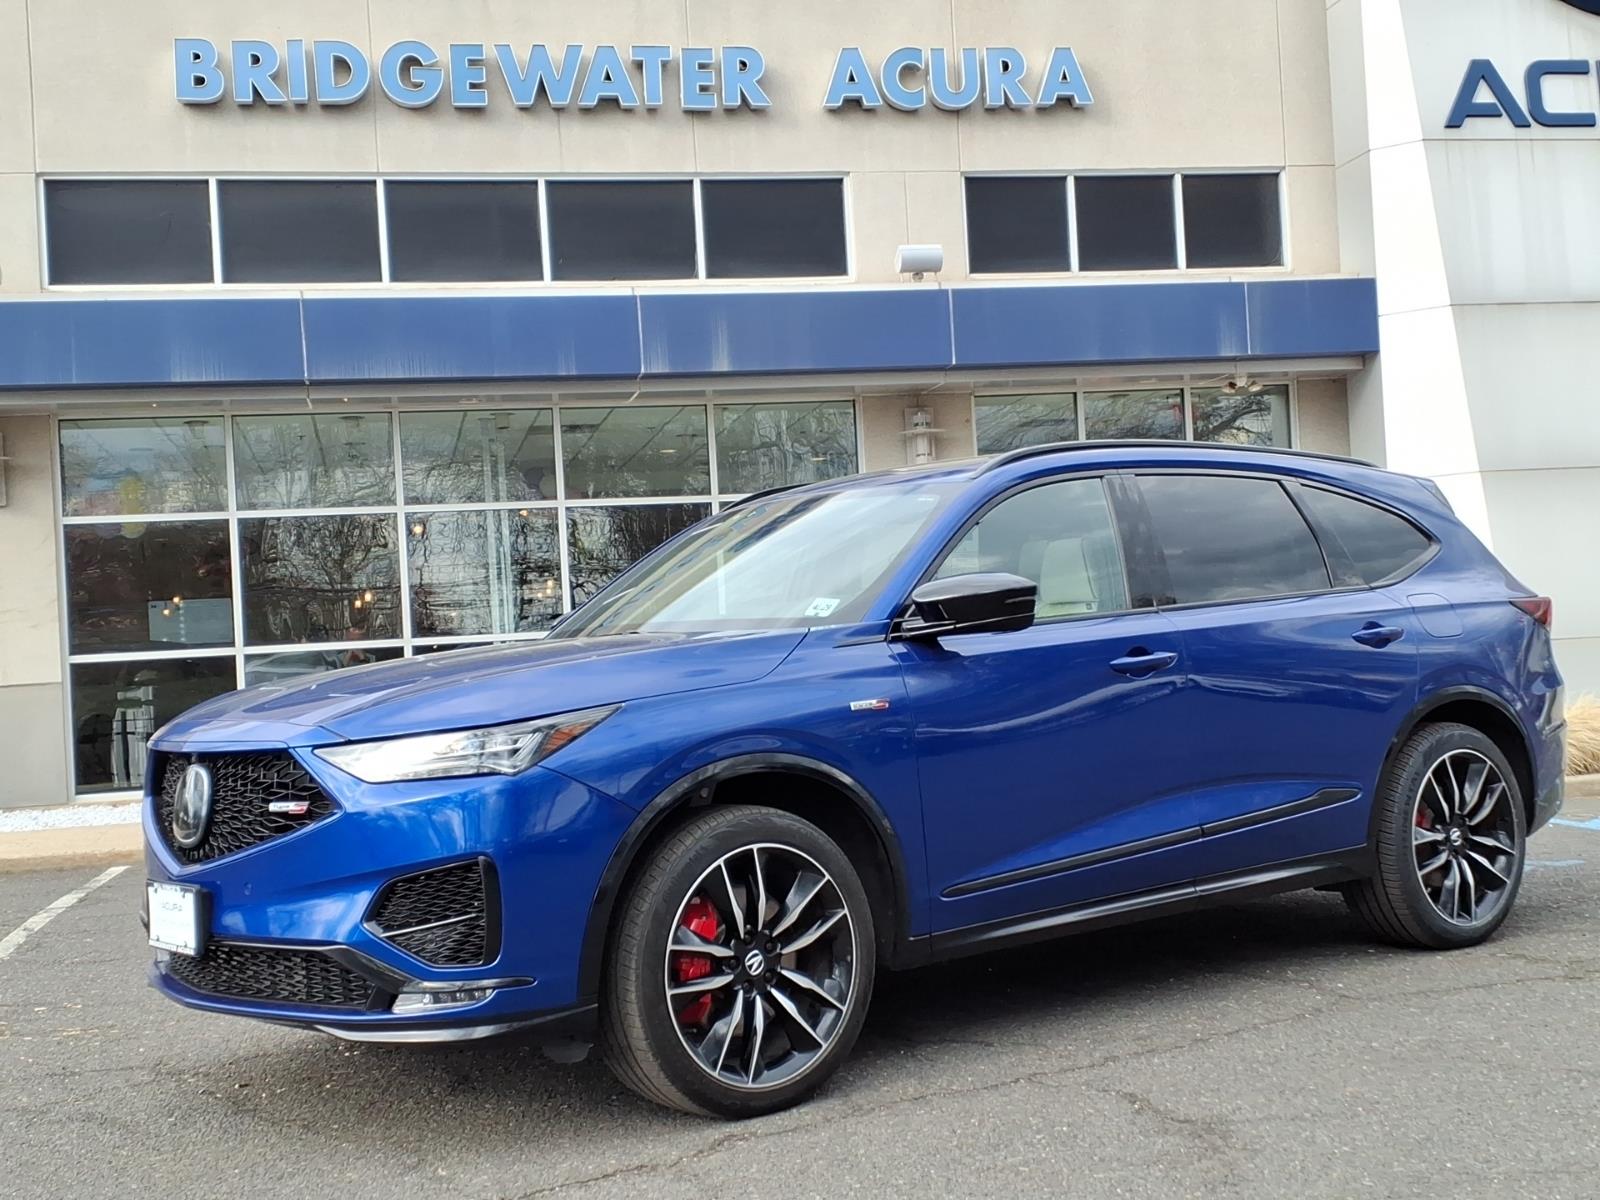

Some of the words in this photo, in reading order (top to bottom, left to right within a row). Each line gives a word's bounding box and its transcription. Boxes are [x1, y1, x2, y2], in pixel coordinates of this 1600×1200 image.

[173, 37, 772, 112] BRIDGEWATER
[823, 46, 1095, 113] ACURA
[1444, 59, 1600, 128] AC
